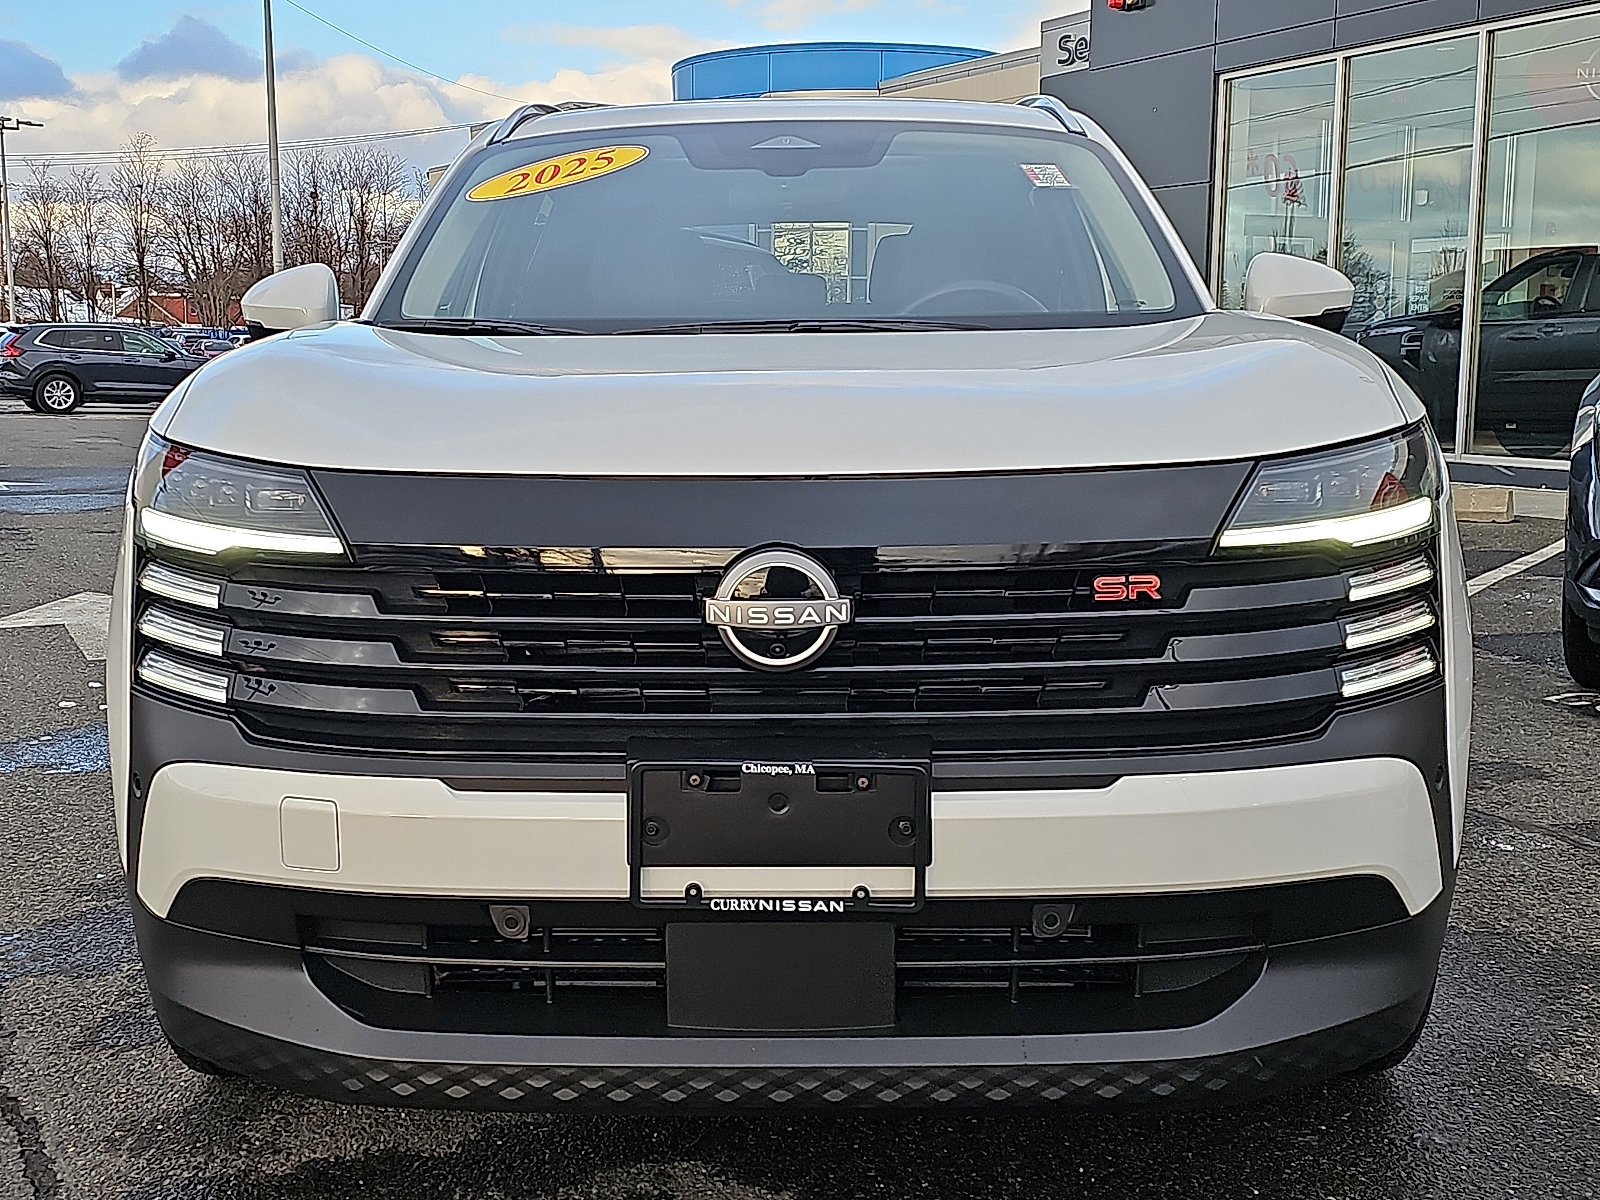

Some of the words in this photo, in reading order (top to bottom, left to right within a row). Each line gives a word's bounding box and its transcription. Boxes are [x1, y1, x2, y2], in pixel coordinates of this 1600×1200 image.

[1057, 34, 1088, 65] Se
[504, 149, 616, 194] 2025
[1094, 575, 1161, 600] SR
[709, 603, 847, 624] NISSAN
[742, 763, 793, 776] Chicopee,
[794, 764, 815, 774] MA
